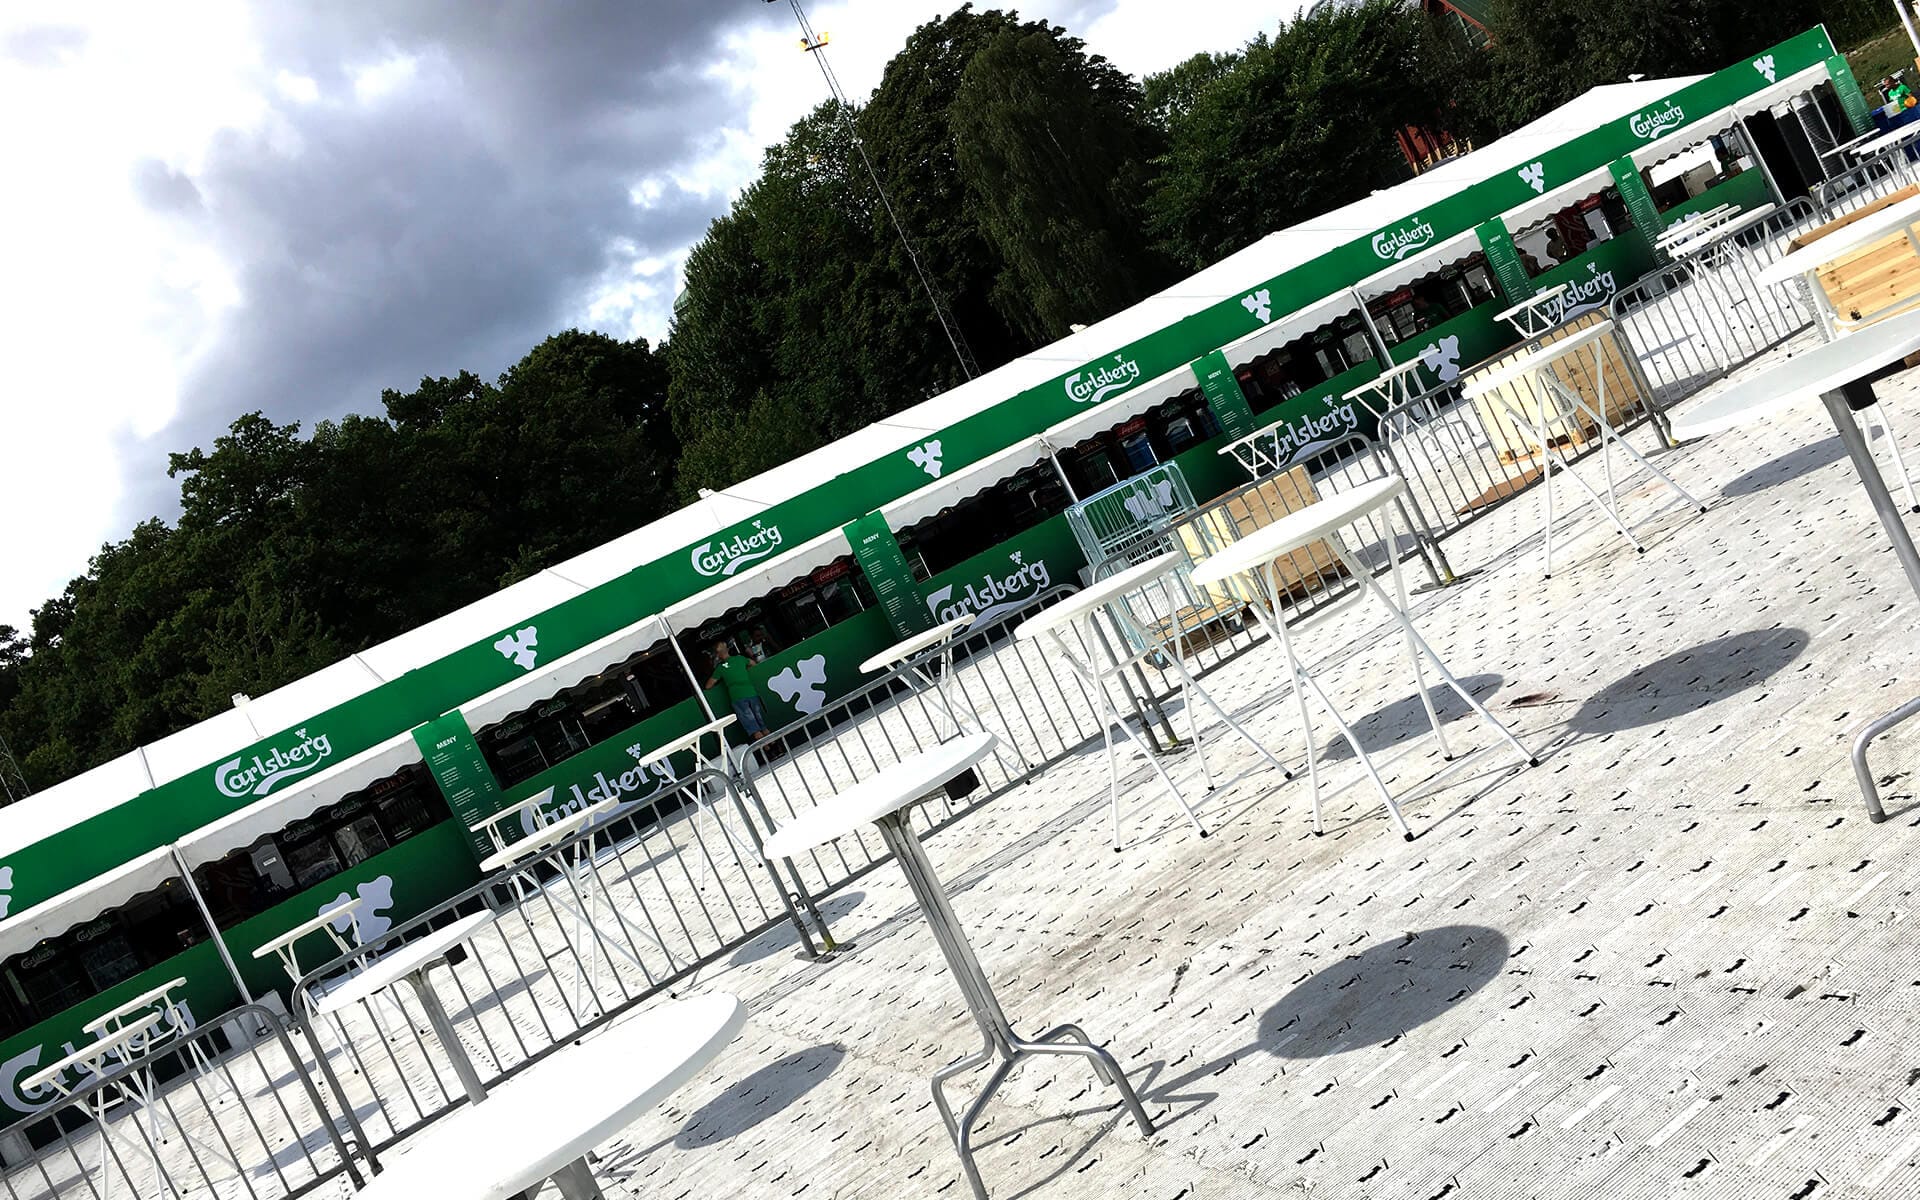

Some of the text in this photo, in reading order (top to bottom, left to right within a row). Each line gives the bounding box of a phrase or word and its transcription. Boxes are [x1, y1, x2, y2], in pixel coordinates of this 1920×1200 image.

[1630, 105, 1685, 139] Carlsberg
[1371, 222, 1435, 260] Carlsberg
[1535, 270, 1617, 326] rlsberg
[1065, 359, 1141, 403] Carlsberg
[1263, 402, 1359, 466] rlsberg
[691, 524, 783, 577] Carlsberg
[926, 559, 1051, 635] Carlsberg
[214, 733, 333, 798] Carlsberg
[435, 734, 458, 750] MENY
